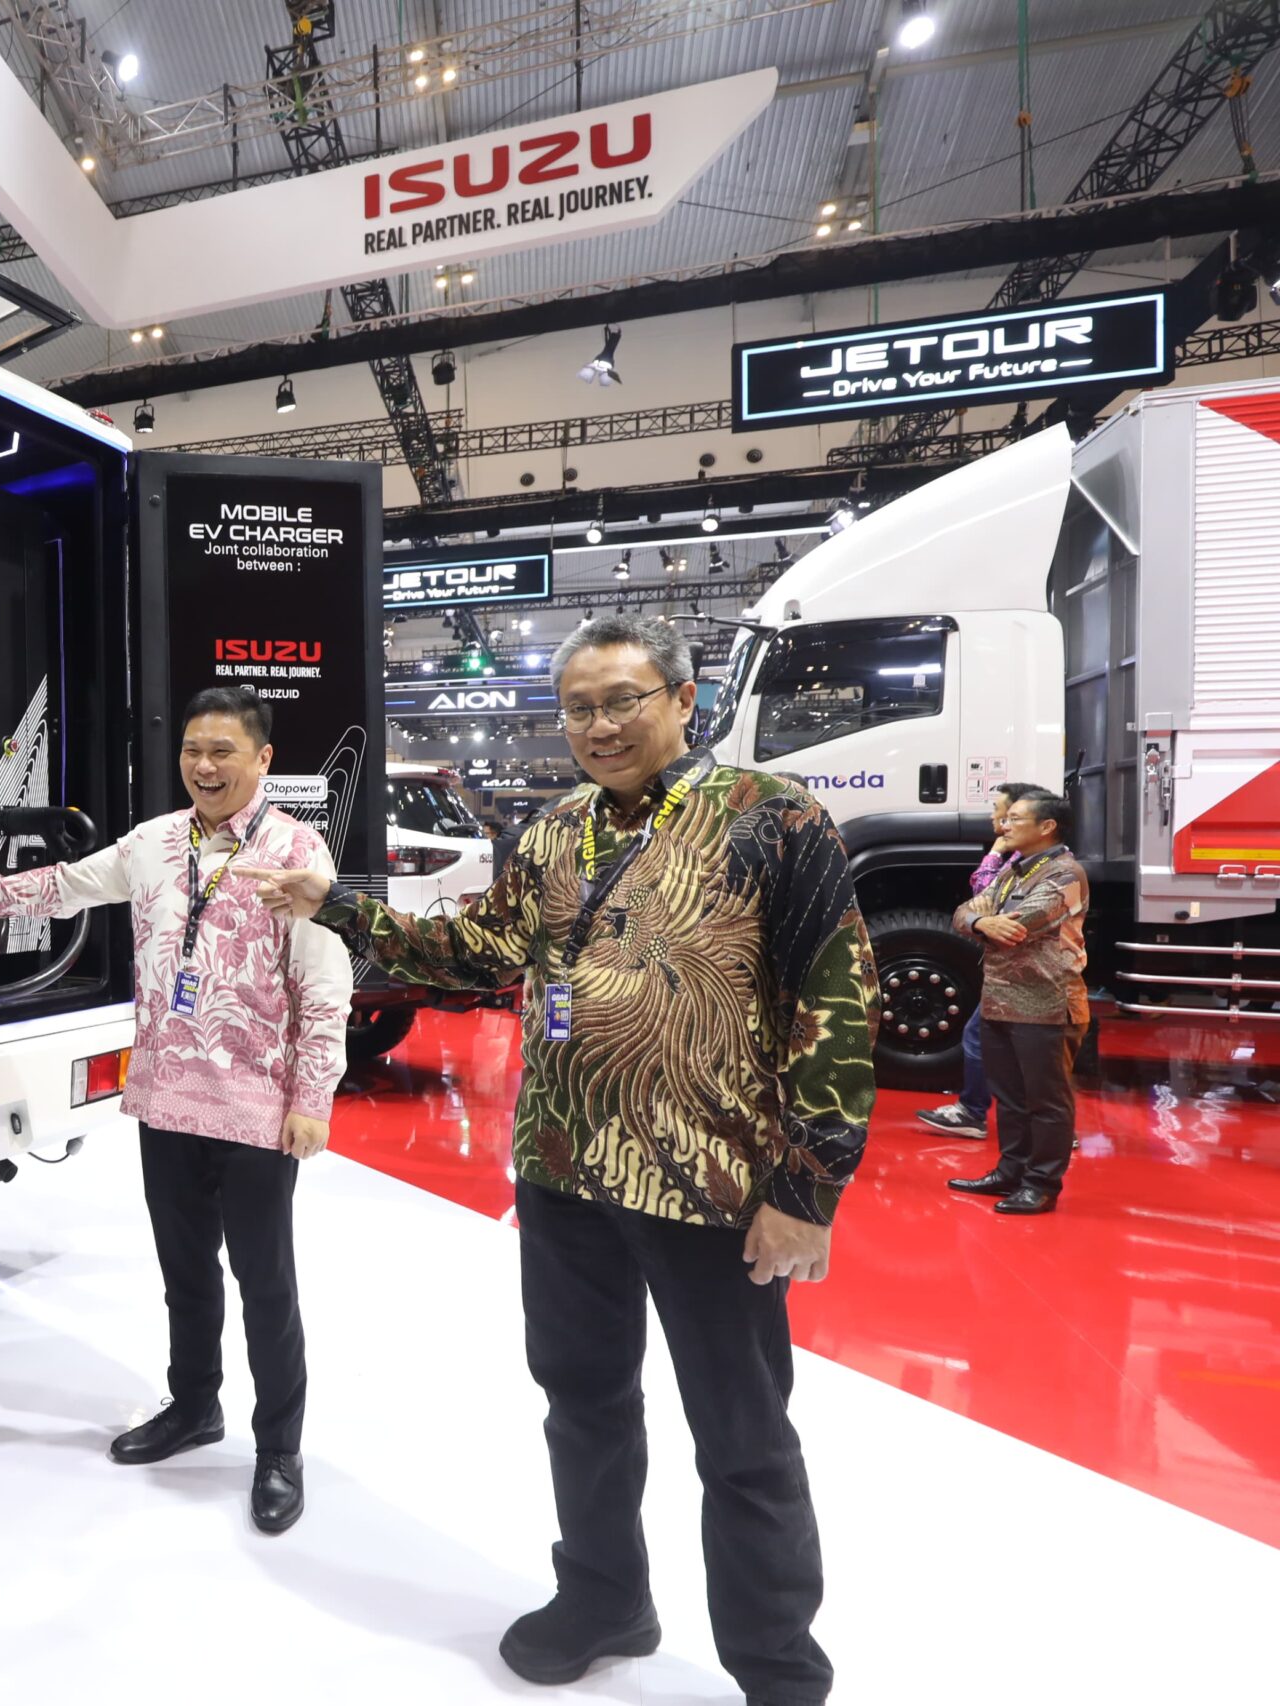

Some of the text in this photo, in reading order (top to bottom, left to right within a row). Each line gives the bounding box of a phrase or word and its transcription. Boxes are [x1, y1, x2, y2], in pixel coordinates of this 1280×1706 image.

[364, 112, 651, 219] ISUZU
[364, 175, 653, 254] REAL PARTNER. REAL JOURNEY.
[800, 316, 1093, 378] JETOUR
[833, 358, 1057, 397] Drive Your Future
[220, 503, 312, 523] MOBILE
[189, 523, 343, 544] EV CHARGER
[204, 542, 329, 558] Joint collaboration
[236, 557, 293, 572] between
[383, 564, 517, 590] JETOUR
[392, 584, 500, 601] Drive Your Future
[215, 639, 322, 662] ISUZU
[215, 665, 321, 679] REAL PARTNER. REAL JOURNEY.
[258, 688, 300, 699] ISUZUID
[428, 690, 516, 709] AION
